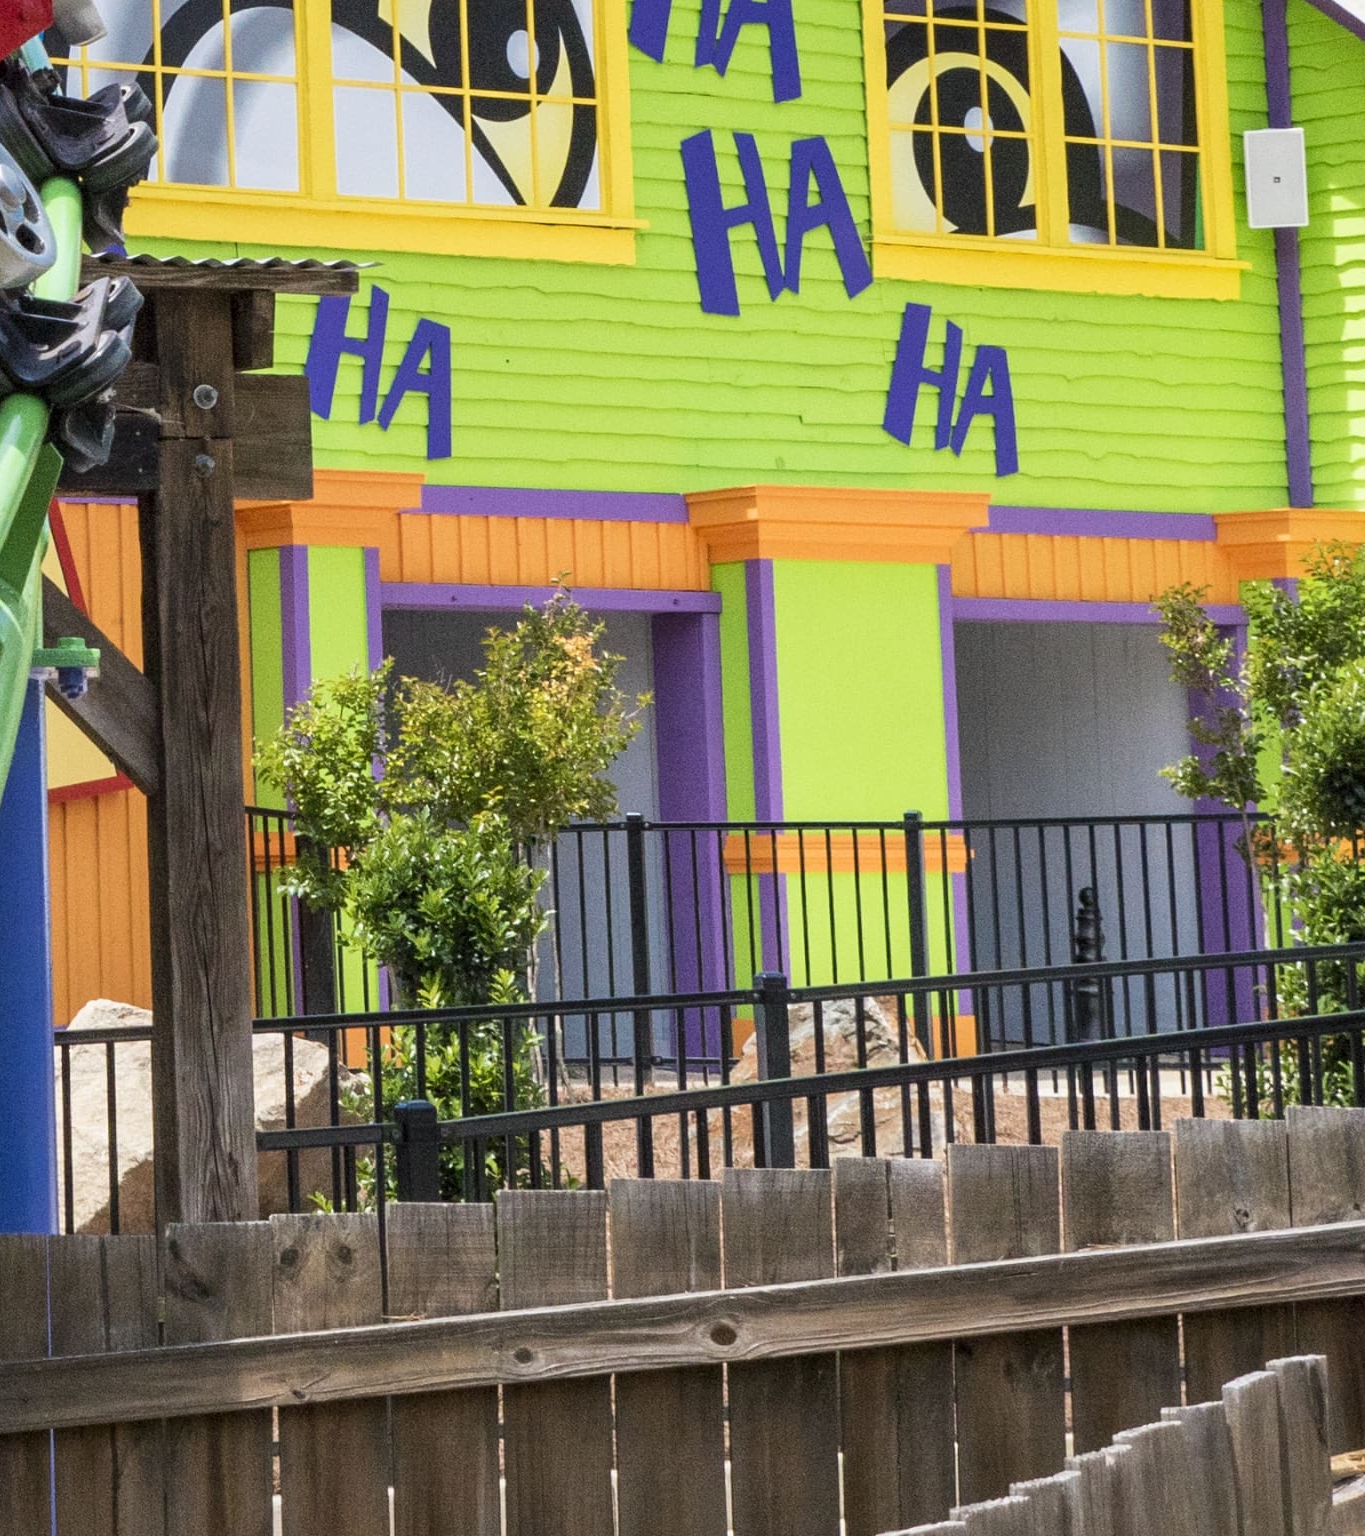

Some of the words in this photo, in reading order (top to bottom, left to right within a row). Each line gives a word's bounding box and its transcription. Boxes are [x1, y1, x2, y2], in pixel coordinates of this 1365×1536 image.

[680, 128, 872, 317] HA
[304, 284, 452, 460] HA
[883, 302, 1019, 477] HA
